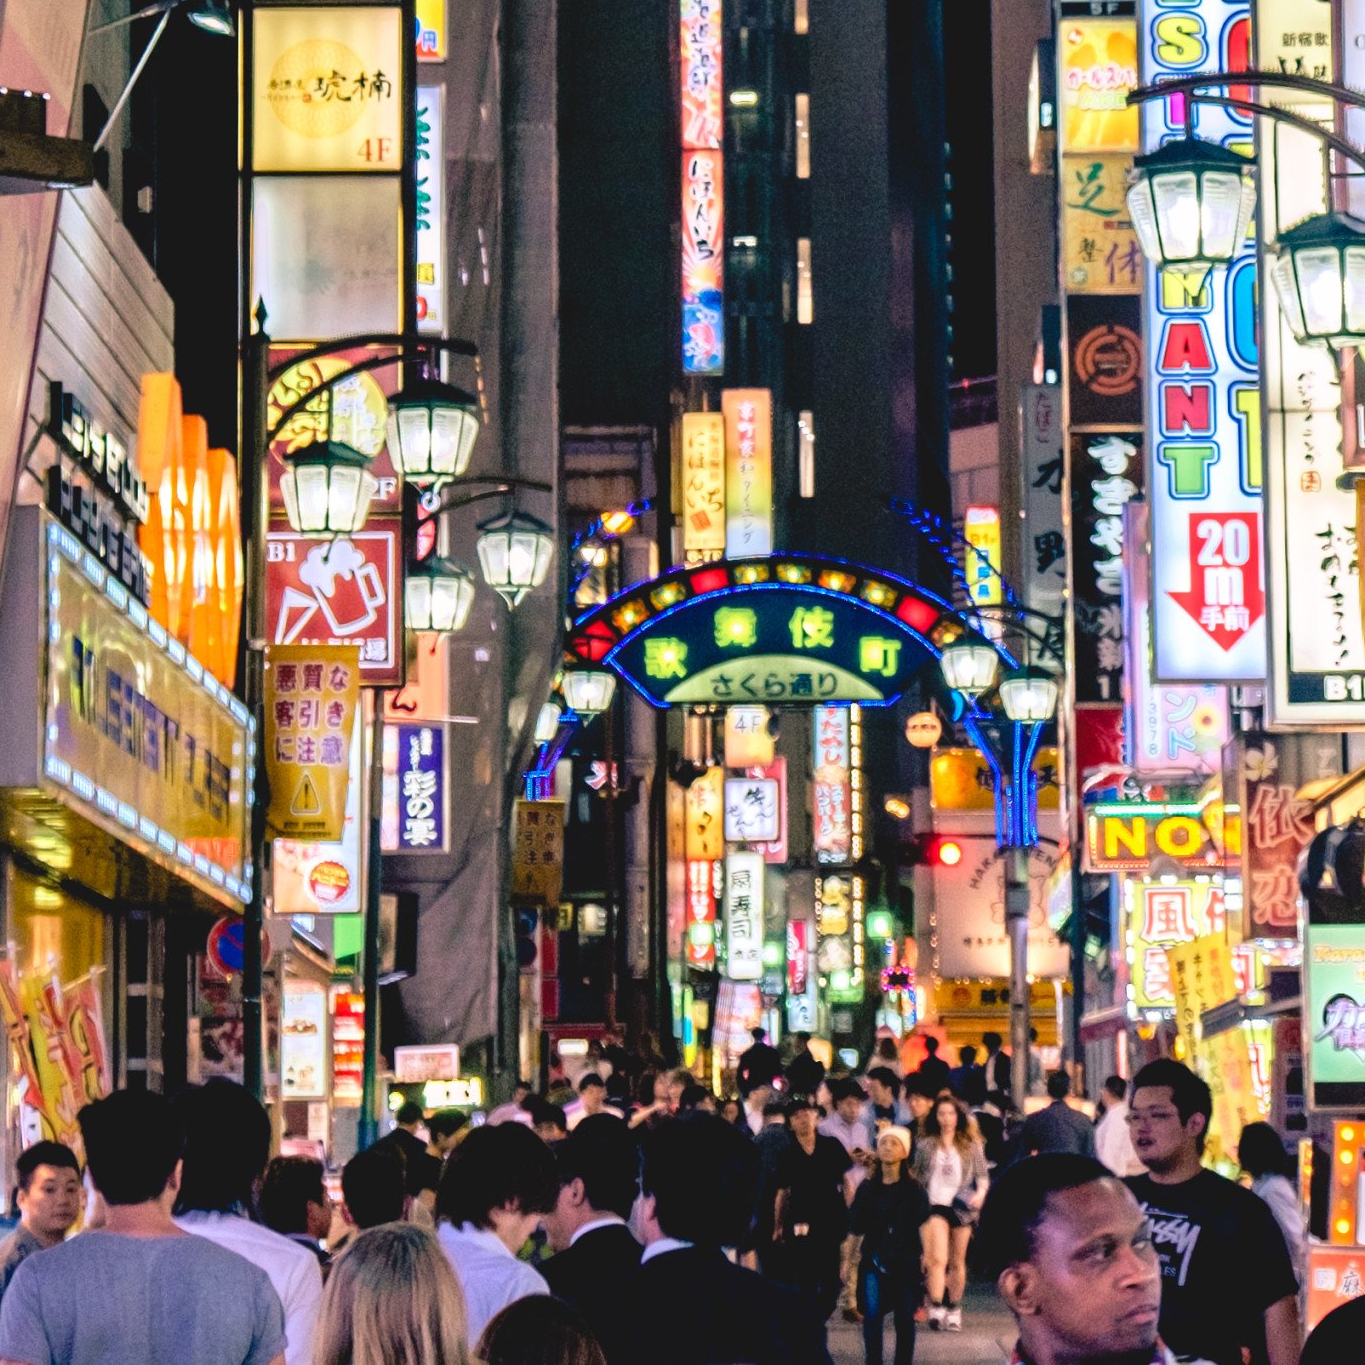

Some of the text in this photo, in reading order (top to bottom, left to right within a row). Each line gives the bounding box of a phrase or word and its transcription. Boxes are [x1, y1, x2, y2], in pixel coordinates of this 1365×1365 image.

[357, 138, 392, 164] 4F
[268, 542, 296, 562] B1
[645, 605, 904, 681] 歌舞伎町
[275, 662, 349, 692] 悪質な
[711, 669, 839, 697] さくら通り
[275, 699, 345, 730] 客引き
[275, 735, 345, 766] に注意
